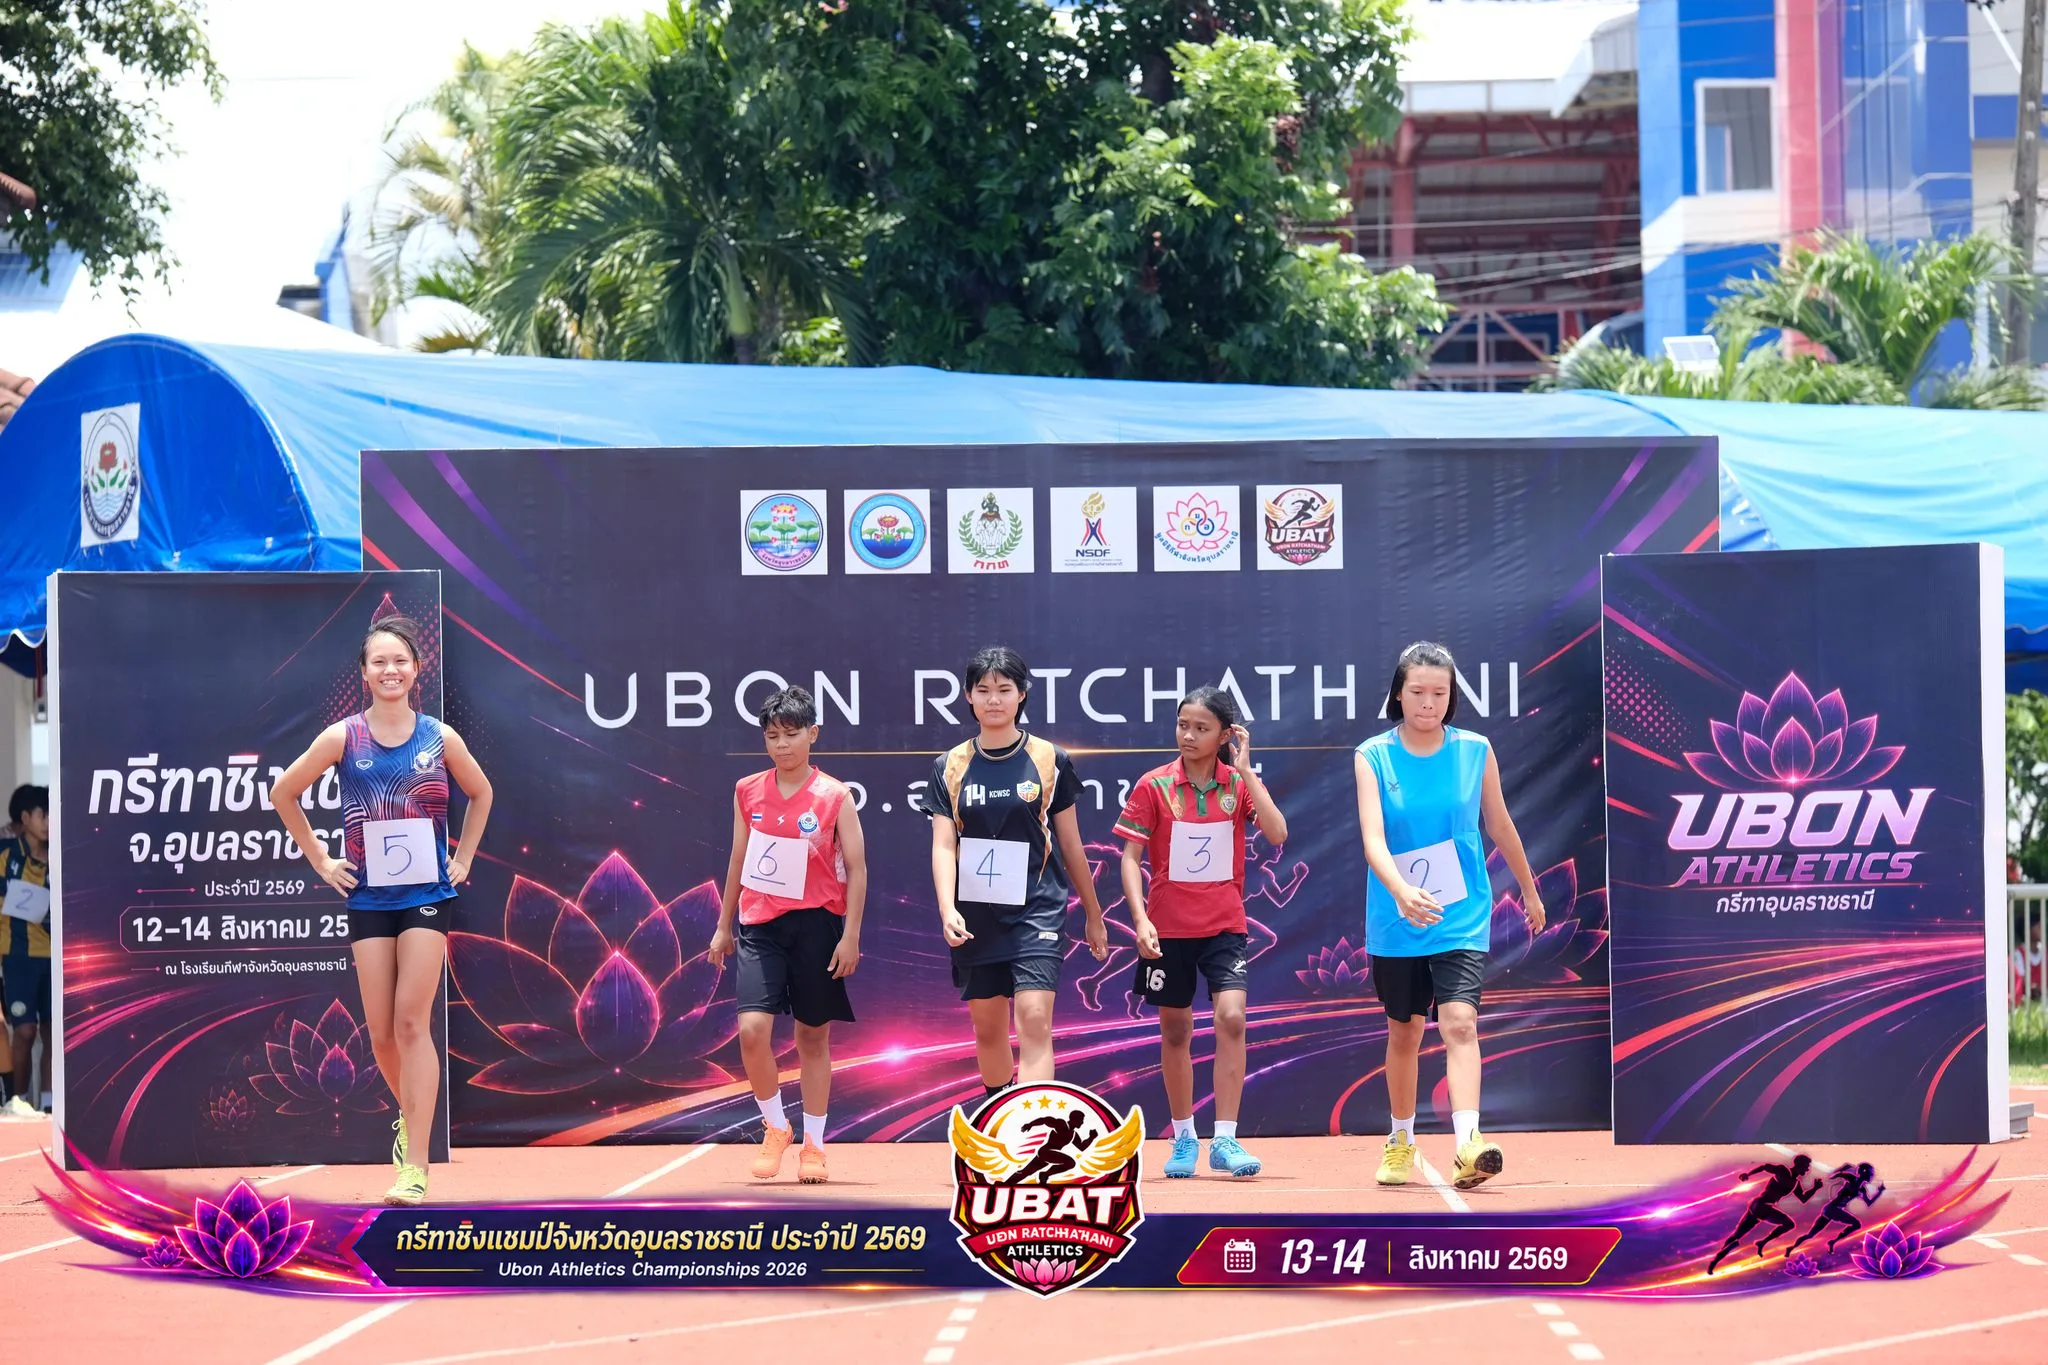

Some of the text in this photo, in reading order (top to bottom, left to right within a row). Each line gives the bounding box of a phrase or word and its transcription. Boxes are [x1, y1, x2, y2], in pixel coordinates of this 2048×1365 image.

[1271, 528, 1329, 543] UBAT
[1075, 549, 1110, 557] NSDF
[585, 662, 1518, 729] UBON RTCHATHNI
[964, 784, 985, 807] 14
[1668, 788, 1936, 850] UBON
[384, 834, 412, 876] 5
[758, 842, 777, 876] 6
[976, 848, 1002, 887] 4
[1186, 836, 1212, 873] 3
[1410, 858, 1442, 895] 2
[1673, 852, 1925, 887] ATHLETICS
[16, 889, 34, 911] 2
[204, 879, 305, 897] ประจำปี 2569
[221, 915, 311, 940] สิงหาคม
[319, 915, 349, 938] 25
[165, 964, 177, 975] ณ
[1146, 966, 1167, 991] 16
